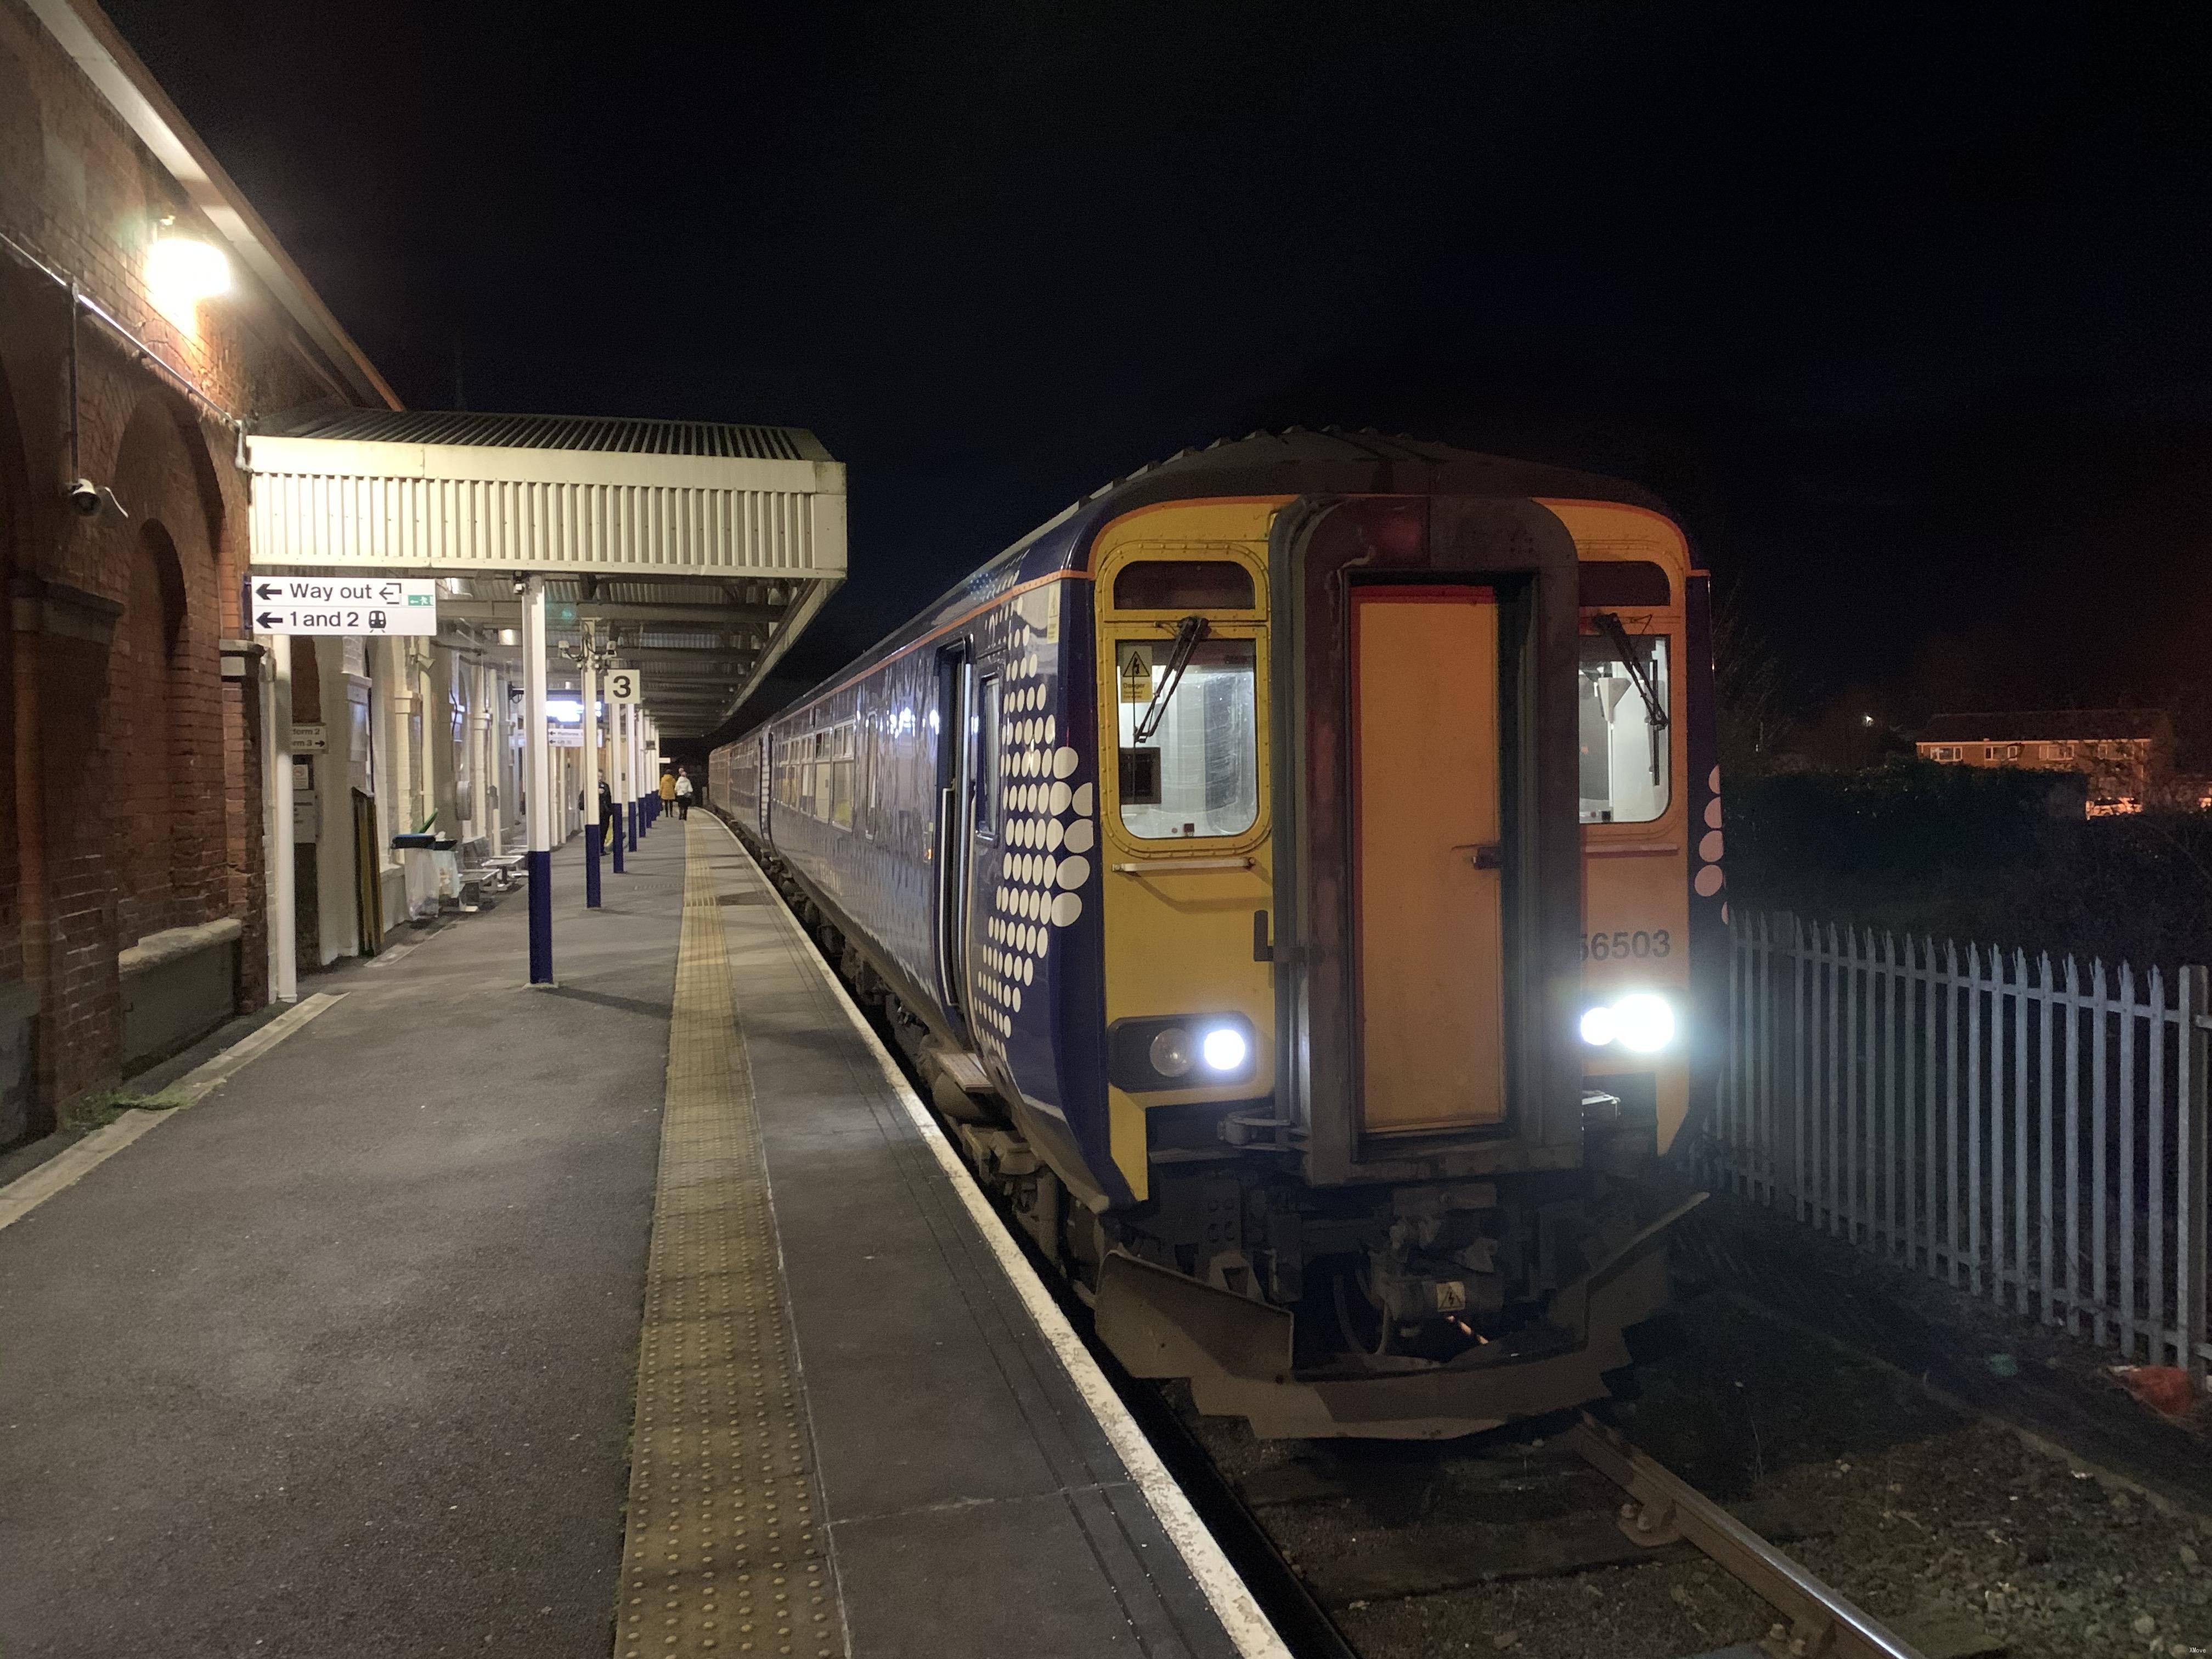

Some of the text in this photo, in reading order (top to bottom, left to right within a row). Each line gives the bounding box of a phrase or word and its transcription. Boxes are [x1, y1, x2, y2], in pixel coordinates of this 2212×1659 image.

[290, 583, 372, 601] Way out
[290, 611, 359, 627] 1 and 2
[613, 675, 631, 698] 3
